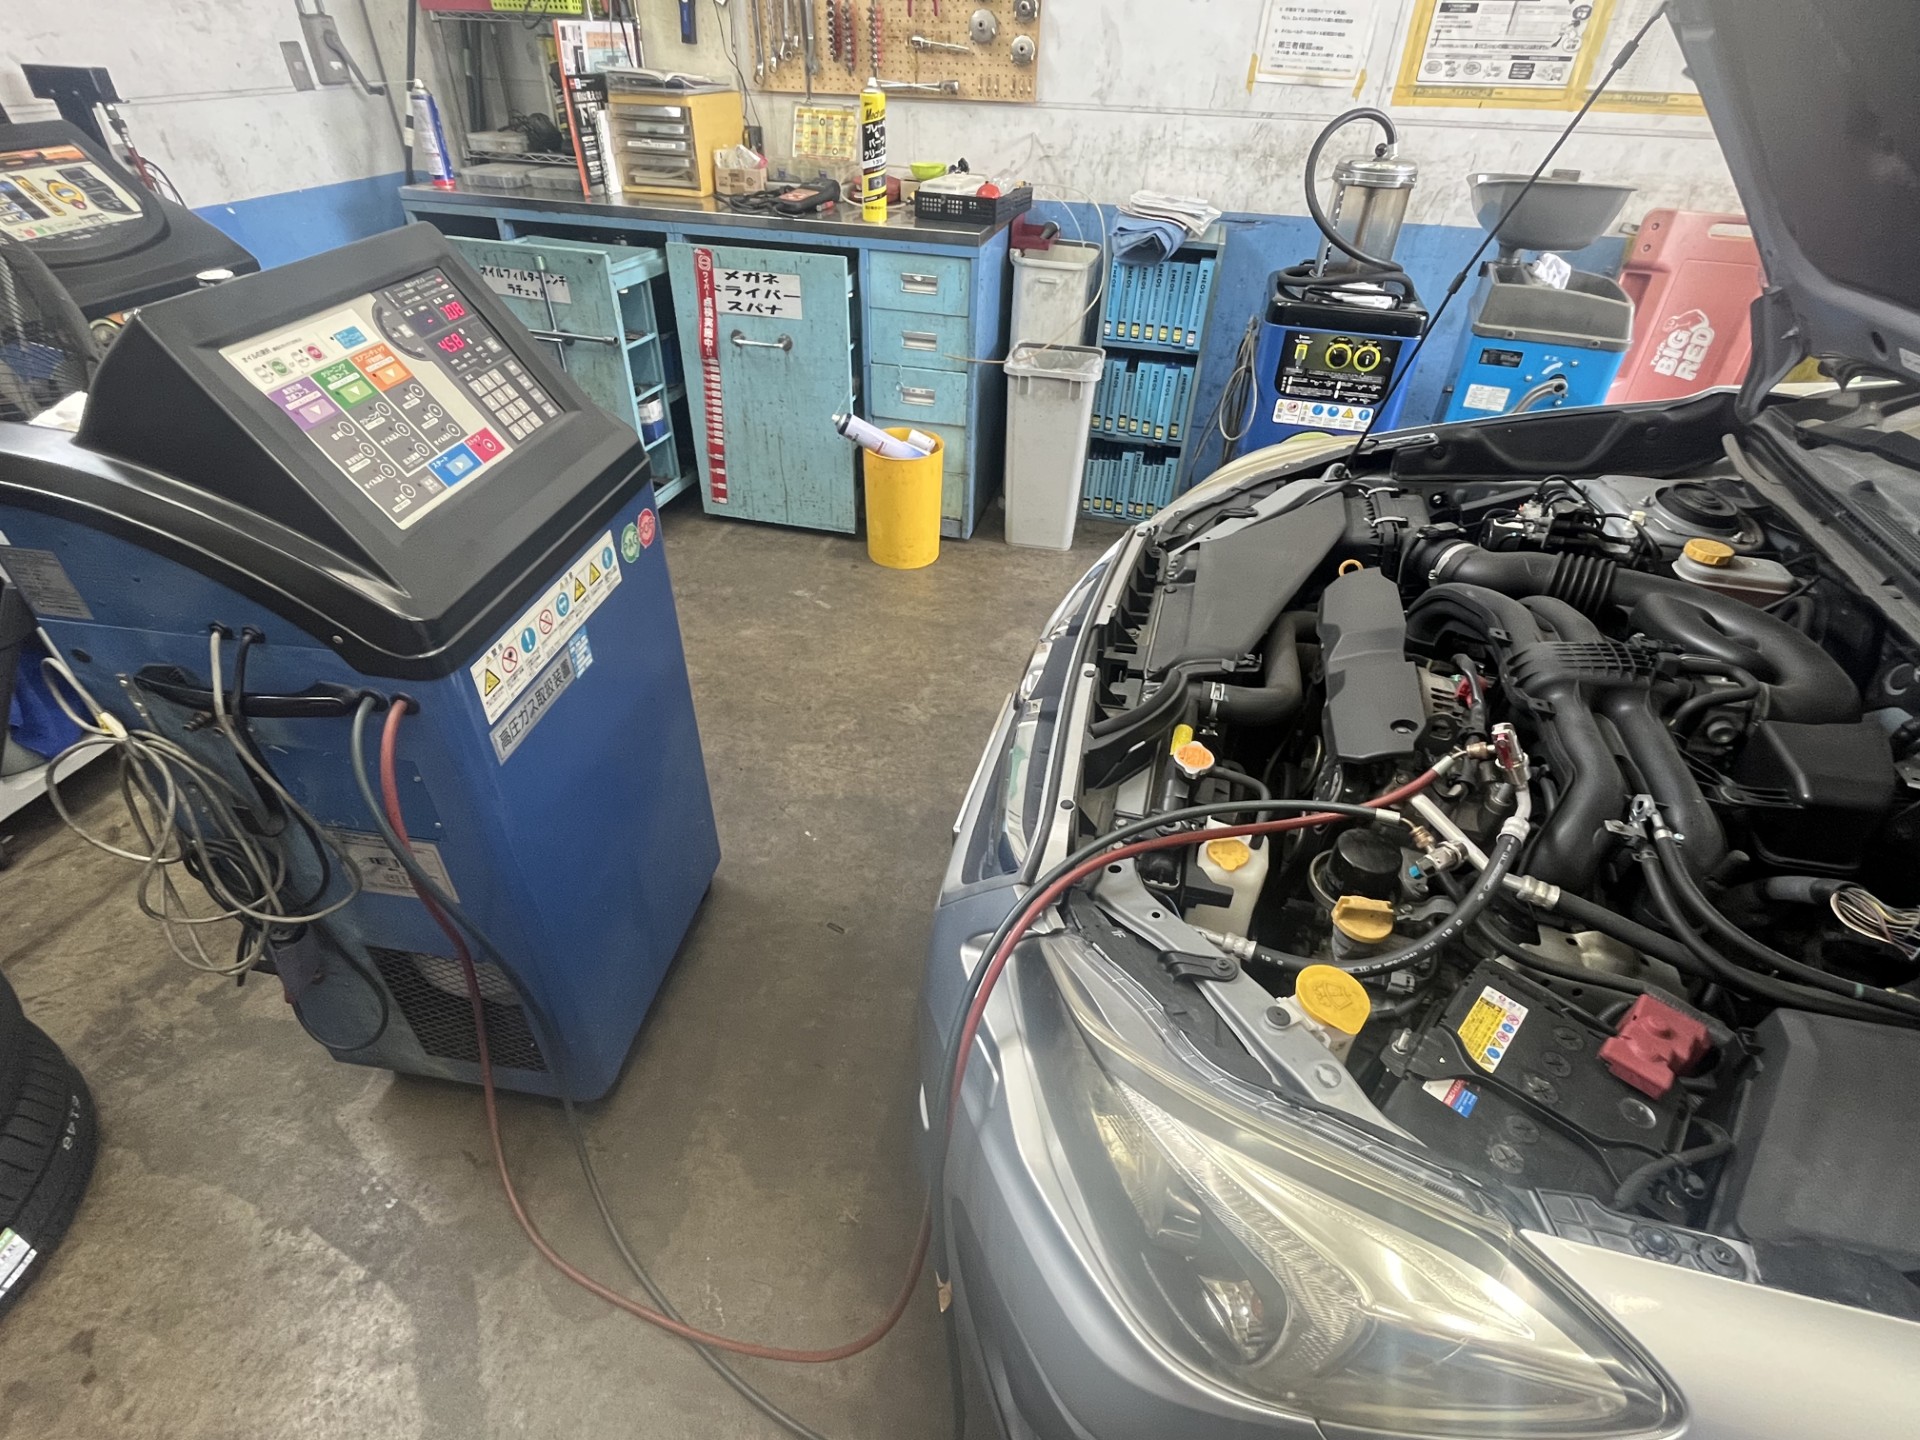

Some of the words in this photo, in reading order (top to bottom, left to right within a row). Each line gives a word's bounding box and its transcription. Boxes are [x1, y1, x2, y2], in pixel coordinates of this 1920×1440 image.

[724, 270, 780, 285] メガネ
[1125, 266, 1134, 288] ENEOS
[1140, 267, 1148, 290] ENEOS
[1156, 264, 1164, 288] ENEOS
[1169, 269, 1177, 292] ENEOS
[1184, 271, 1192, 294] ENEOS
[1200, 269, 1208, 294] ENEOS
[438, 332, 464, 352] 458
[1654, 329, 1692, 376] BIG
[1674, 327, 1715, 382] RED
[1138, 370, 1146, 390] ENEOS
[1164, 376, 1172, 396] ENEOS
[1180, 374, 1188, 394] ENEOS
[431, 456, 449, 470] スタート
